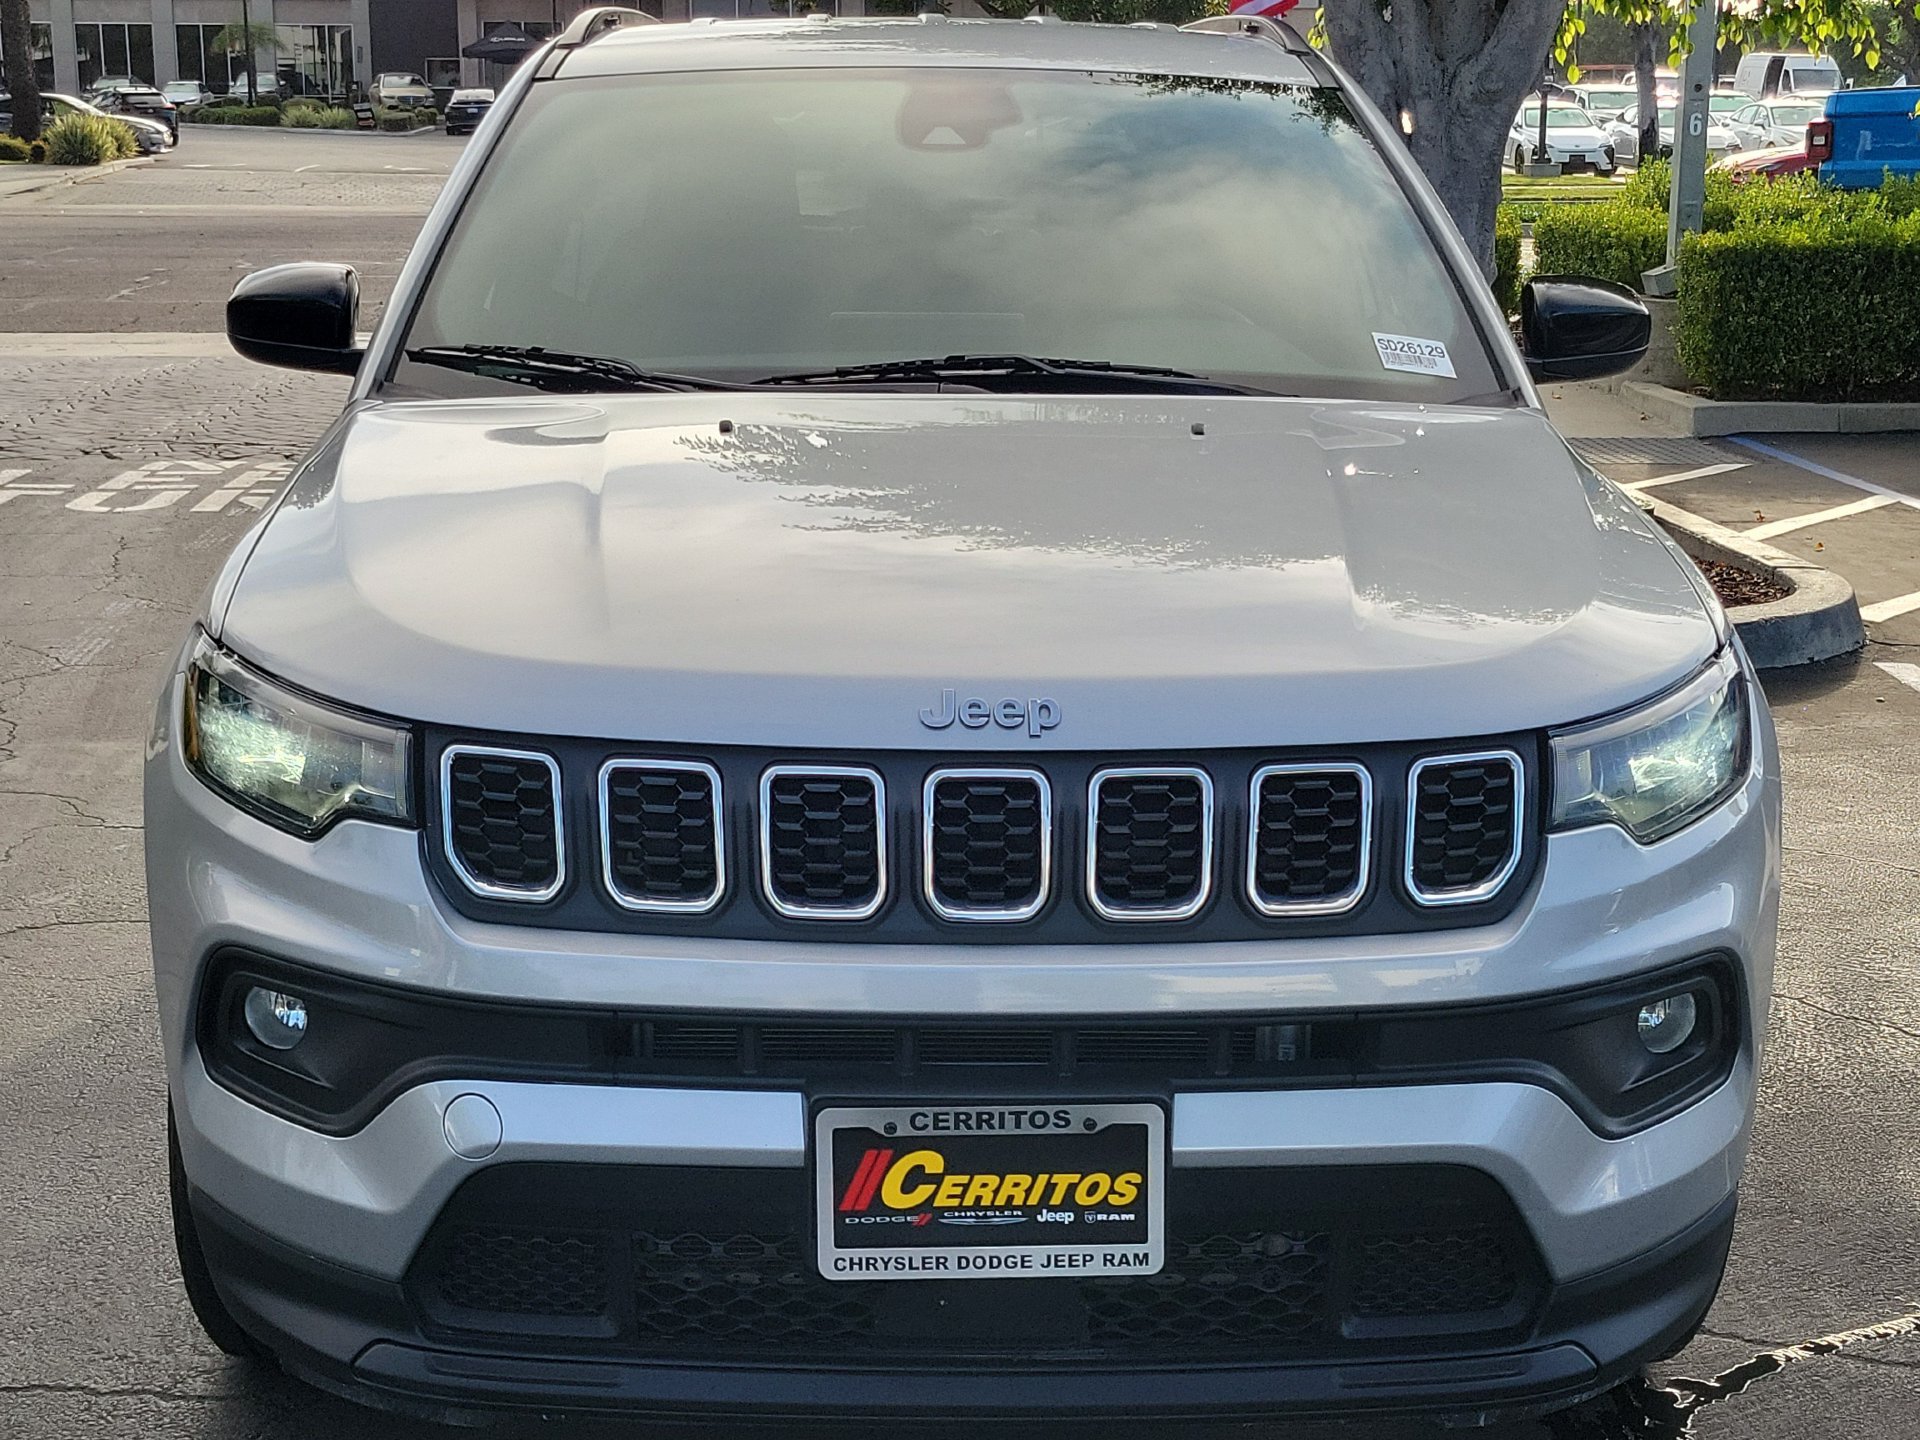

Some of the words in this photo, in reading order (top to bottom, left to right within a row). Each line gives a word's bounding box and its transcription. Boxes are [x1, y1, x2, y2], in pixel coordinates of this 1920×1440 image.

[1690, 112, 1702, 136] 6
[1377, 338, 1446, 359] SD26129
[919, 688, 1062, 738] Jeep
[909, 1109, 1072, 1132] CERRITOS
[881, 1150, 1143, 1210] CERRITOS
[845, 1215, 920, 1224] DODGE
[1036, 1208, 1075, 1224] Jeep
[1097, 1213, 1135, 1221] RAM
[833, 1255, 949, 1273] CHRYSLER
[956, 1254, 1033, 1270] DODGE
[1040, 1252, 1095, 1269] JEEP
[1102, 1252, 1150, 1268] RAM
